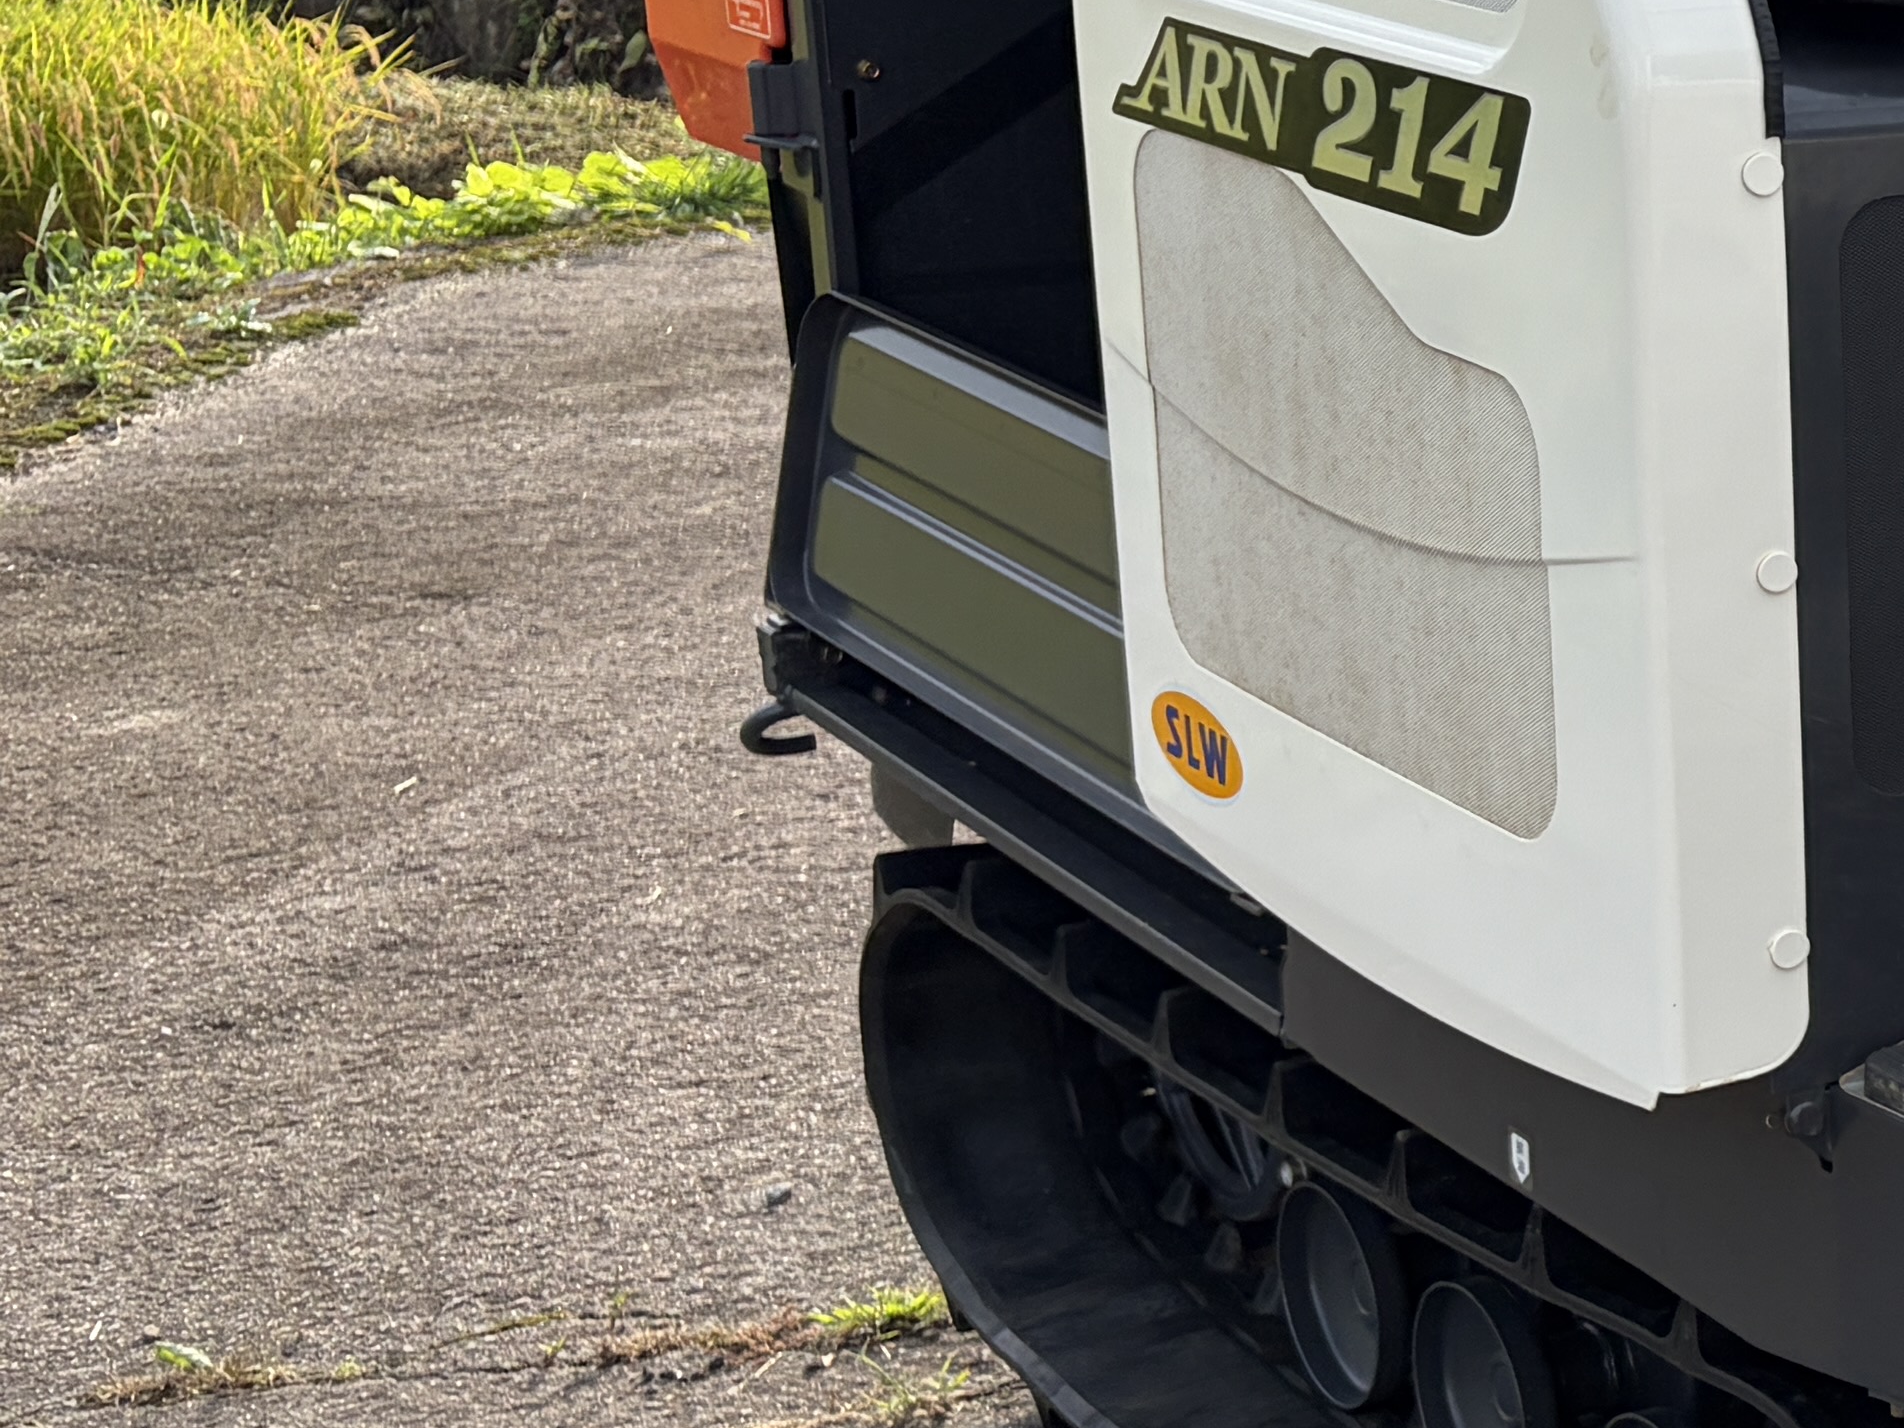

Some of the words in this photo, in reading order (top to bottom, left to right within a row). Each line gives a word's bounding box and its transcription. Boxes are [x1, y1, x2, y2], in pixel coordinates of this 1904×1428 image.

[1120, 26, 1296, 151] ARN
[1312, 58, 1504, 216] 214
[1166, 704, 1227, 786] SLW
